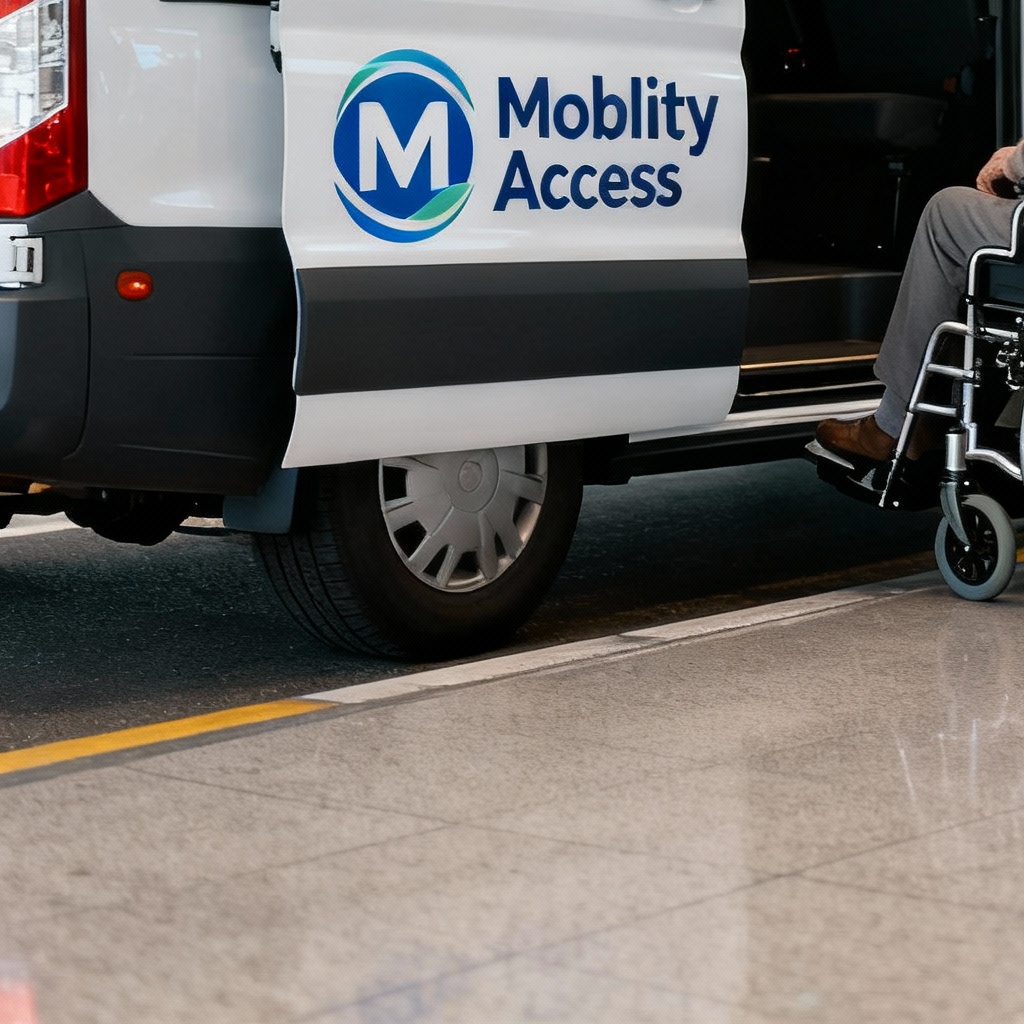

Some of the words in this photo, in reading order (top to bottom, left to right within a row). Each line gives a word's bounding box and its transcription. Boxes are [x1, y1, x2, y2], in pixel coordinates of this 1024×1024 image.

[358, 101, 449, 192] M
[498, 74, 719, 157] Moblity
[493, 149, 683, 212] Access
